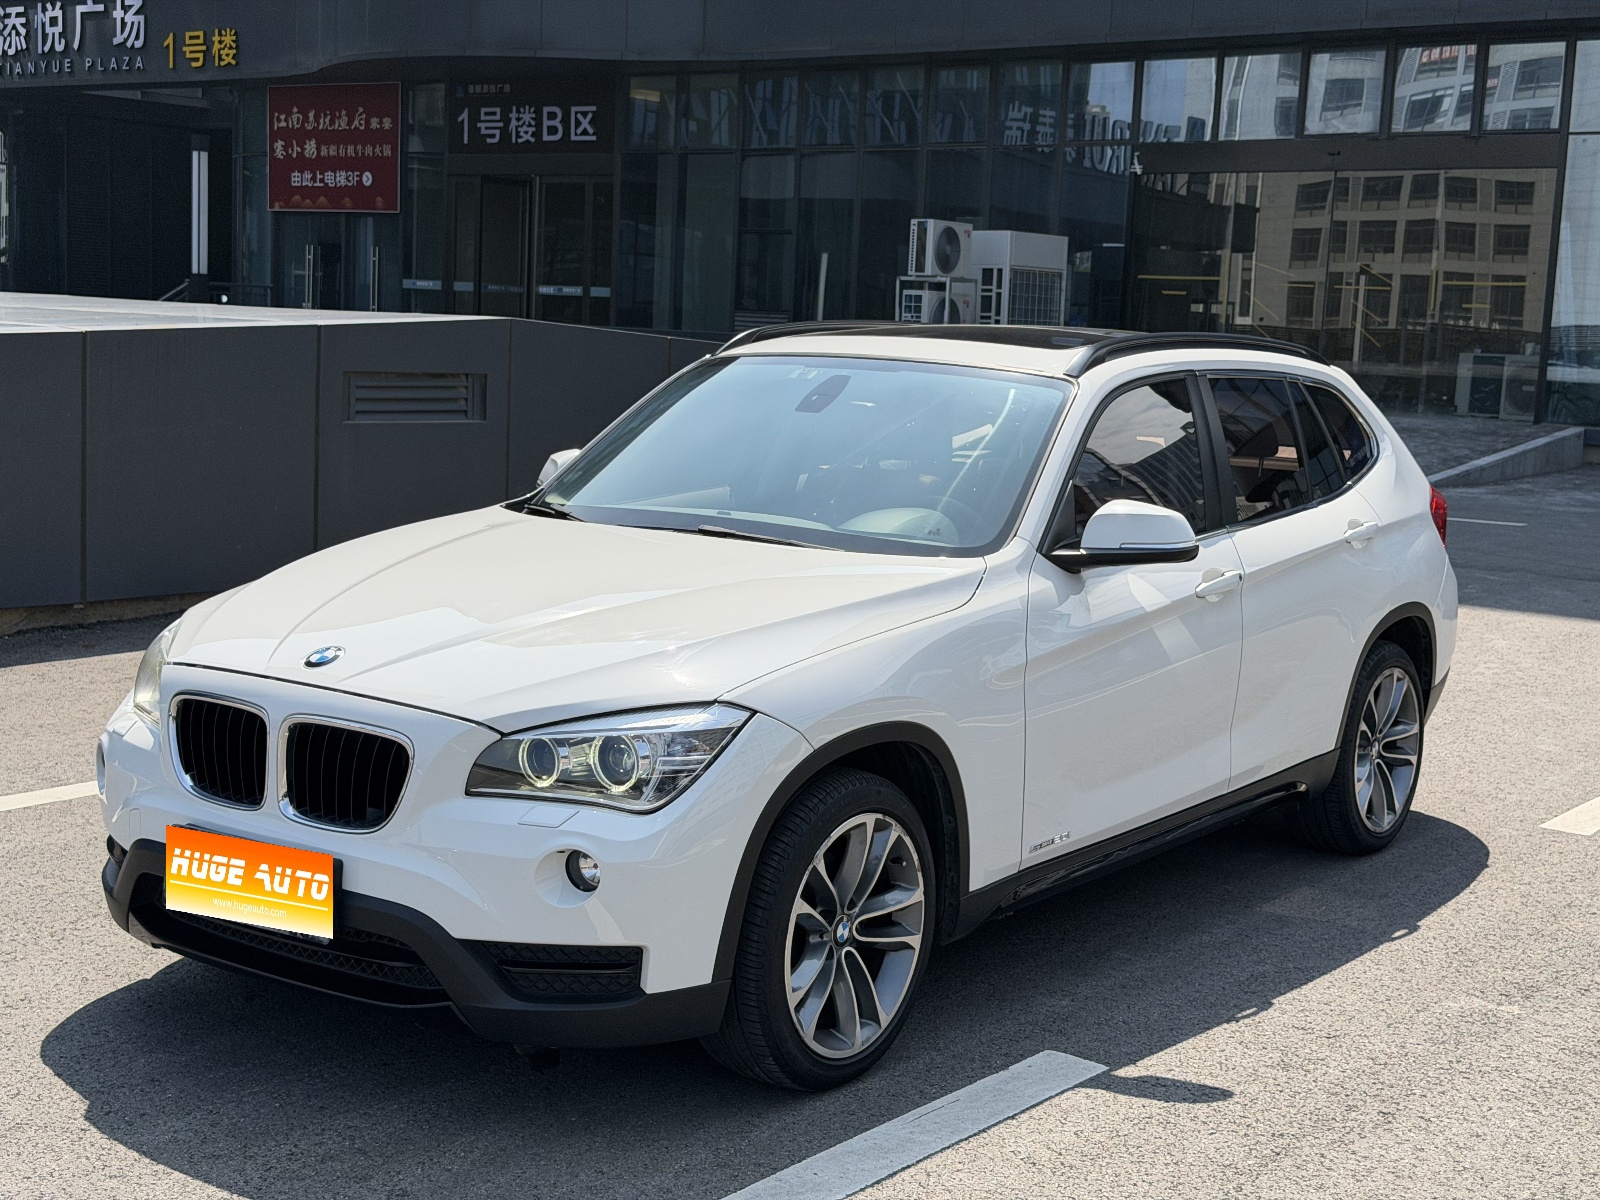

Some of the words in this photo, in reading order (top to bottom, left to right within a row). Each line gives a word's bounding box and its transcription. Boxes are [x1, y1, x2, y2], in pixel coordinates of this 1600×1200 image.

[0, 0, 145, 56] 添悦广场
[86, 56, 144, 71] PLAZA
[163, 28, 237, 69] 1号楼
[457, 105, 597, 144] 1号楼B区
[291, 170, 361, 188] 由此上电梯3F
